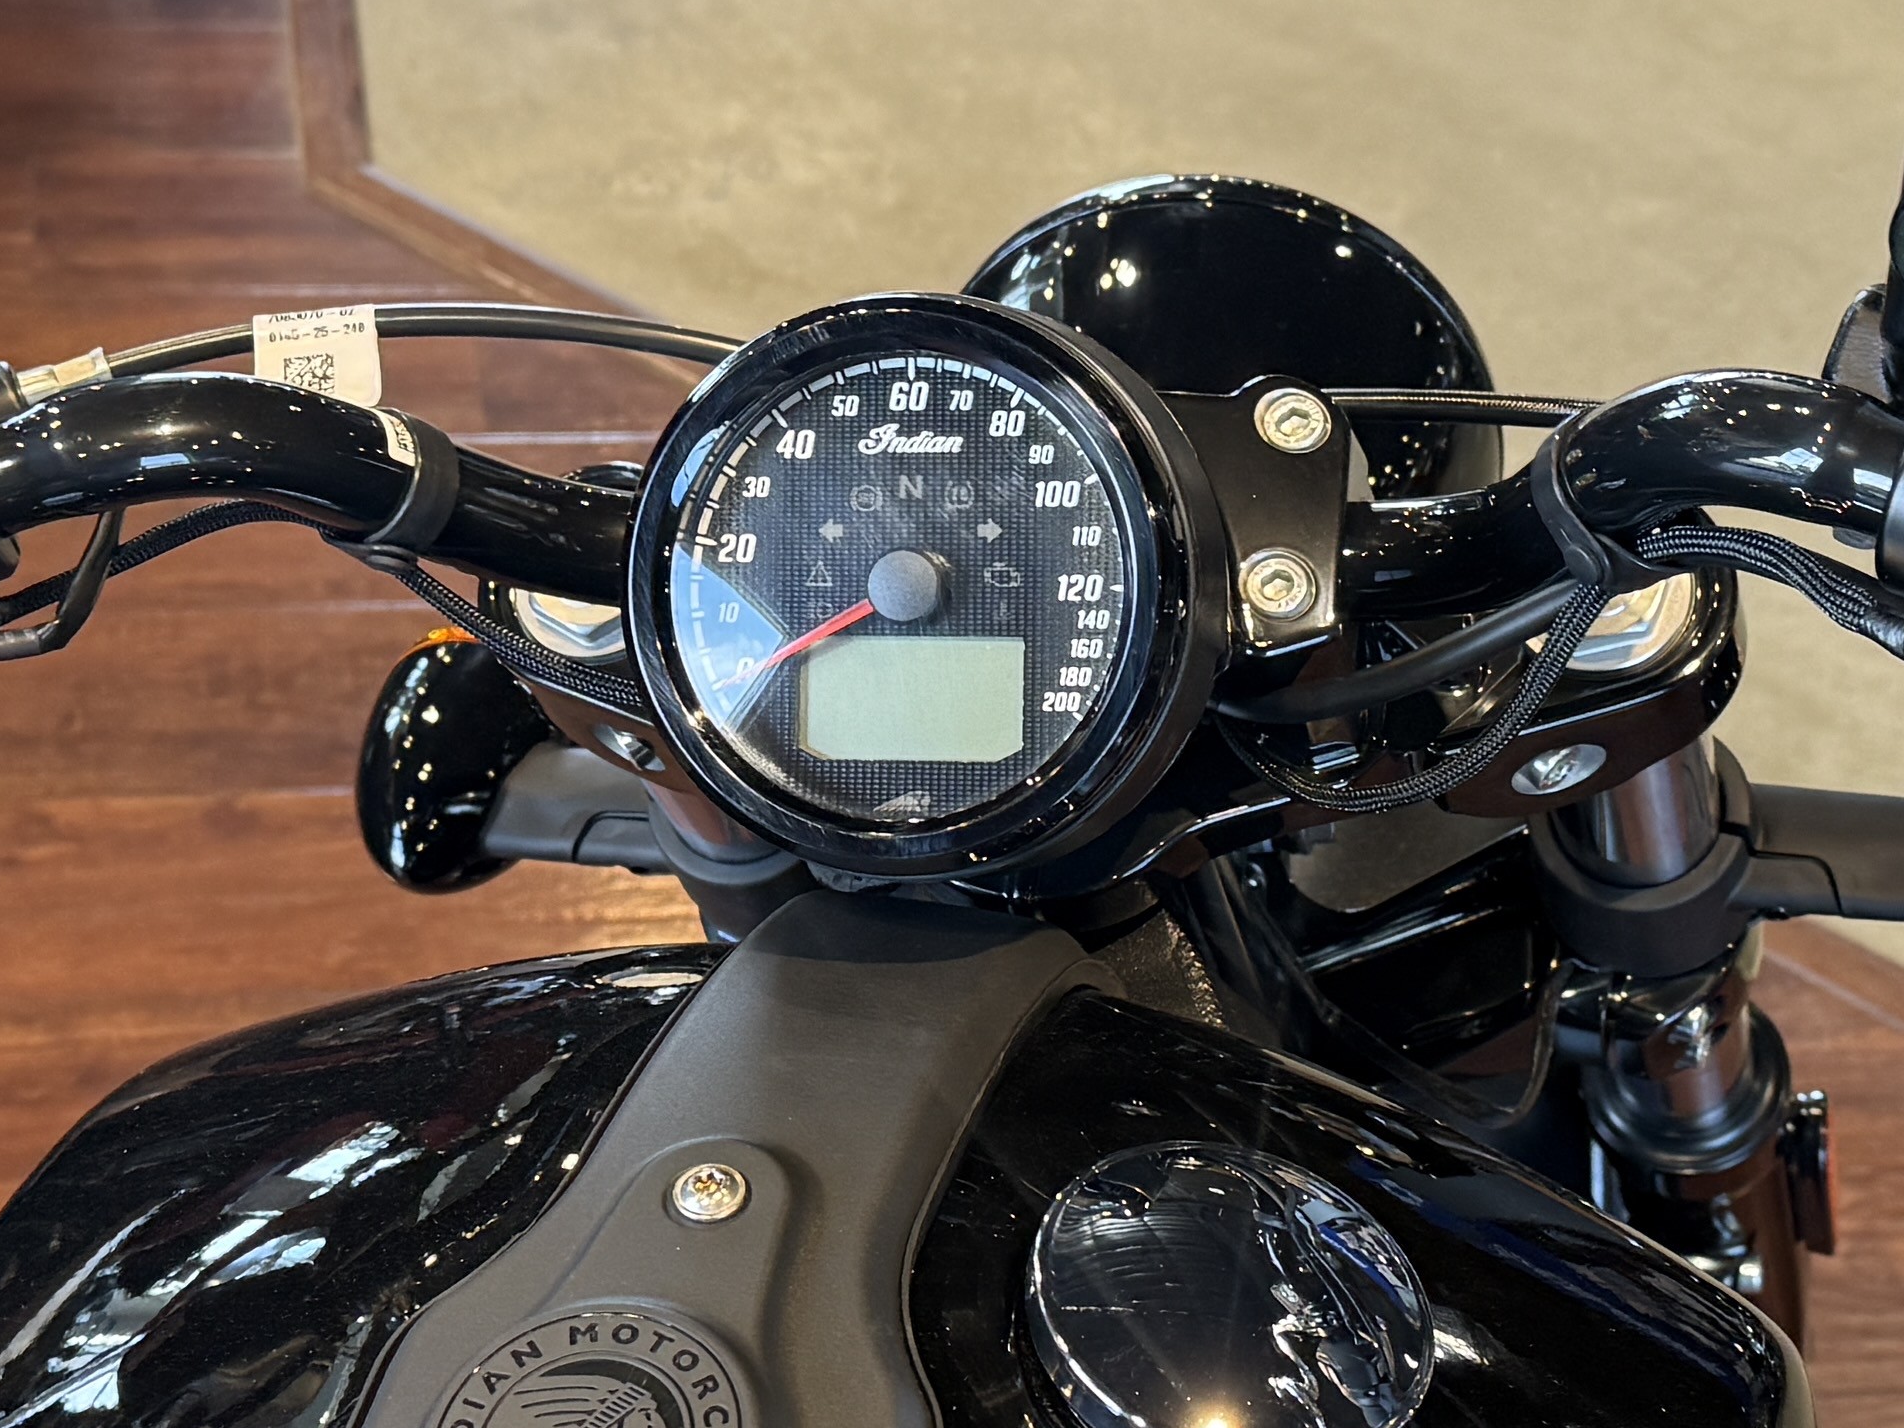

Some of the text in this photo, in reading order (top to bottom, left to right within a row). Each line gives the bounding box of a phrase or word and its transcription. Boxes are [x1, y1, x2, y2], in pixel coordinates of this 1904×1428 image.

[831, 395, 860, 417] 50
[889, 381, 929, 411] 60
[949, 390, 974, 411] 70
[989, 410, 1025, 437] 80
[776, 429, 816, 459] 40
[858, 423, 964, 455] Indian
[1028, 444, 1055, 465] 90
[742, 476, 771, 498] 30
[898, 474, 923, 499] N
[1033, 480, 1081, 508] 100
[1072, 526, 1102, 546] 110
[718, 533, 757, 563] 20
[1058, 574, 1104, 602] 120
[718, 602, 740, 623] 10
[1077, 610, 1110, 629] 140
[1070, 638, 1103, 658] 160
[1059, 666, 1092, 687] 180
[1042, 691, 1081, 712] 200
